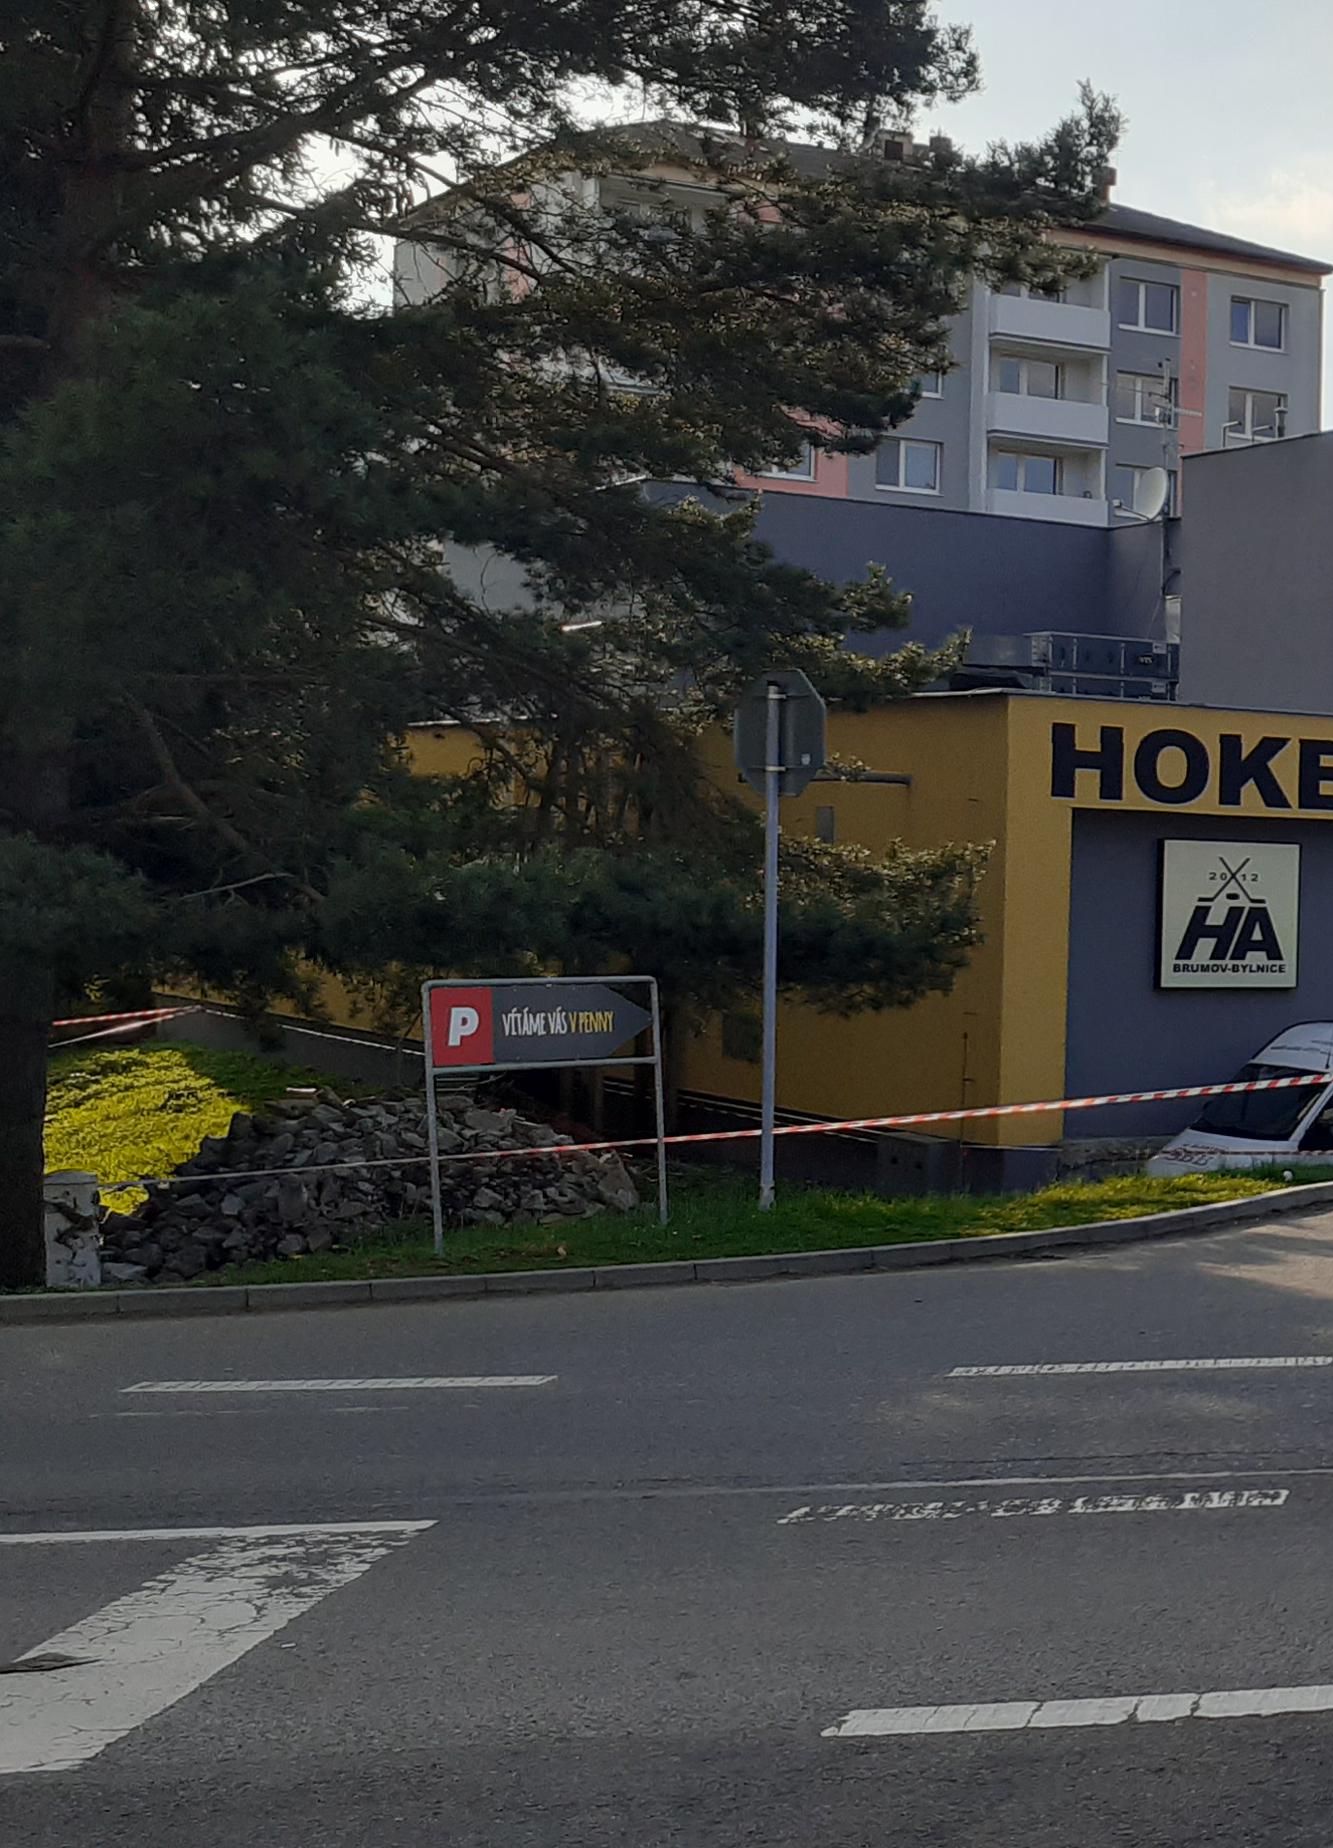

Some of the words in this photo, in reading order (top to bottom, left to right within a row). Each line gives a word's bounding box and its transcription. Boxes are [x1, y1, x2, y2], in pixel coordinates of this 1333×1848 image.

[1175, 905, 1284, 961] HA
[1172, 963, 1286, 973] BRUMOV-BYLNICE
[447, 1006, 480, 1047] P
[502, 1006, 546, 1036] VÍTÁME
[547, 1006, 568, 1035] VÁS
[570, 1011, 578, 1032] V
[578, 1010, 613, 1034] PENNY
